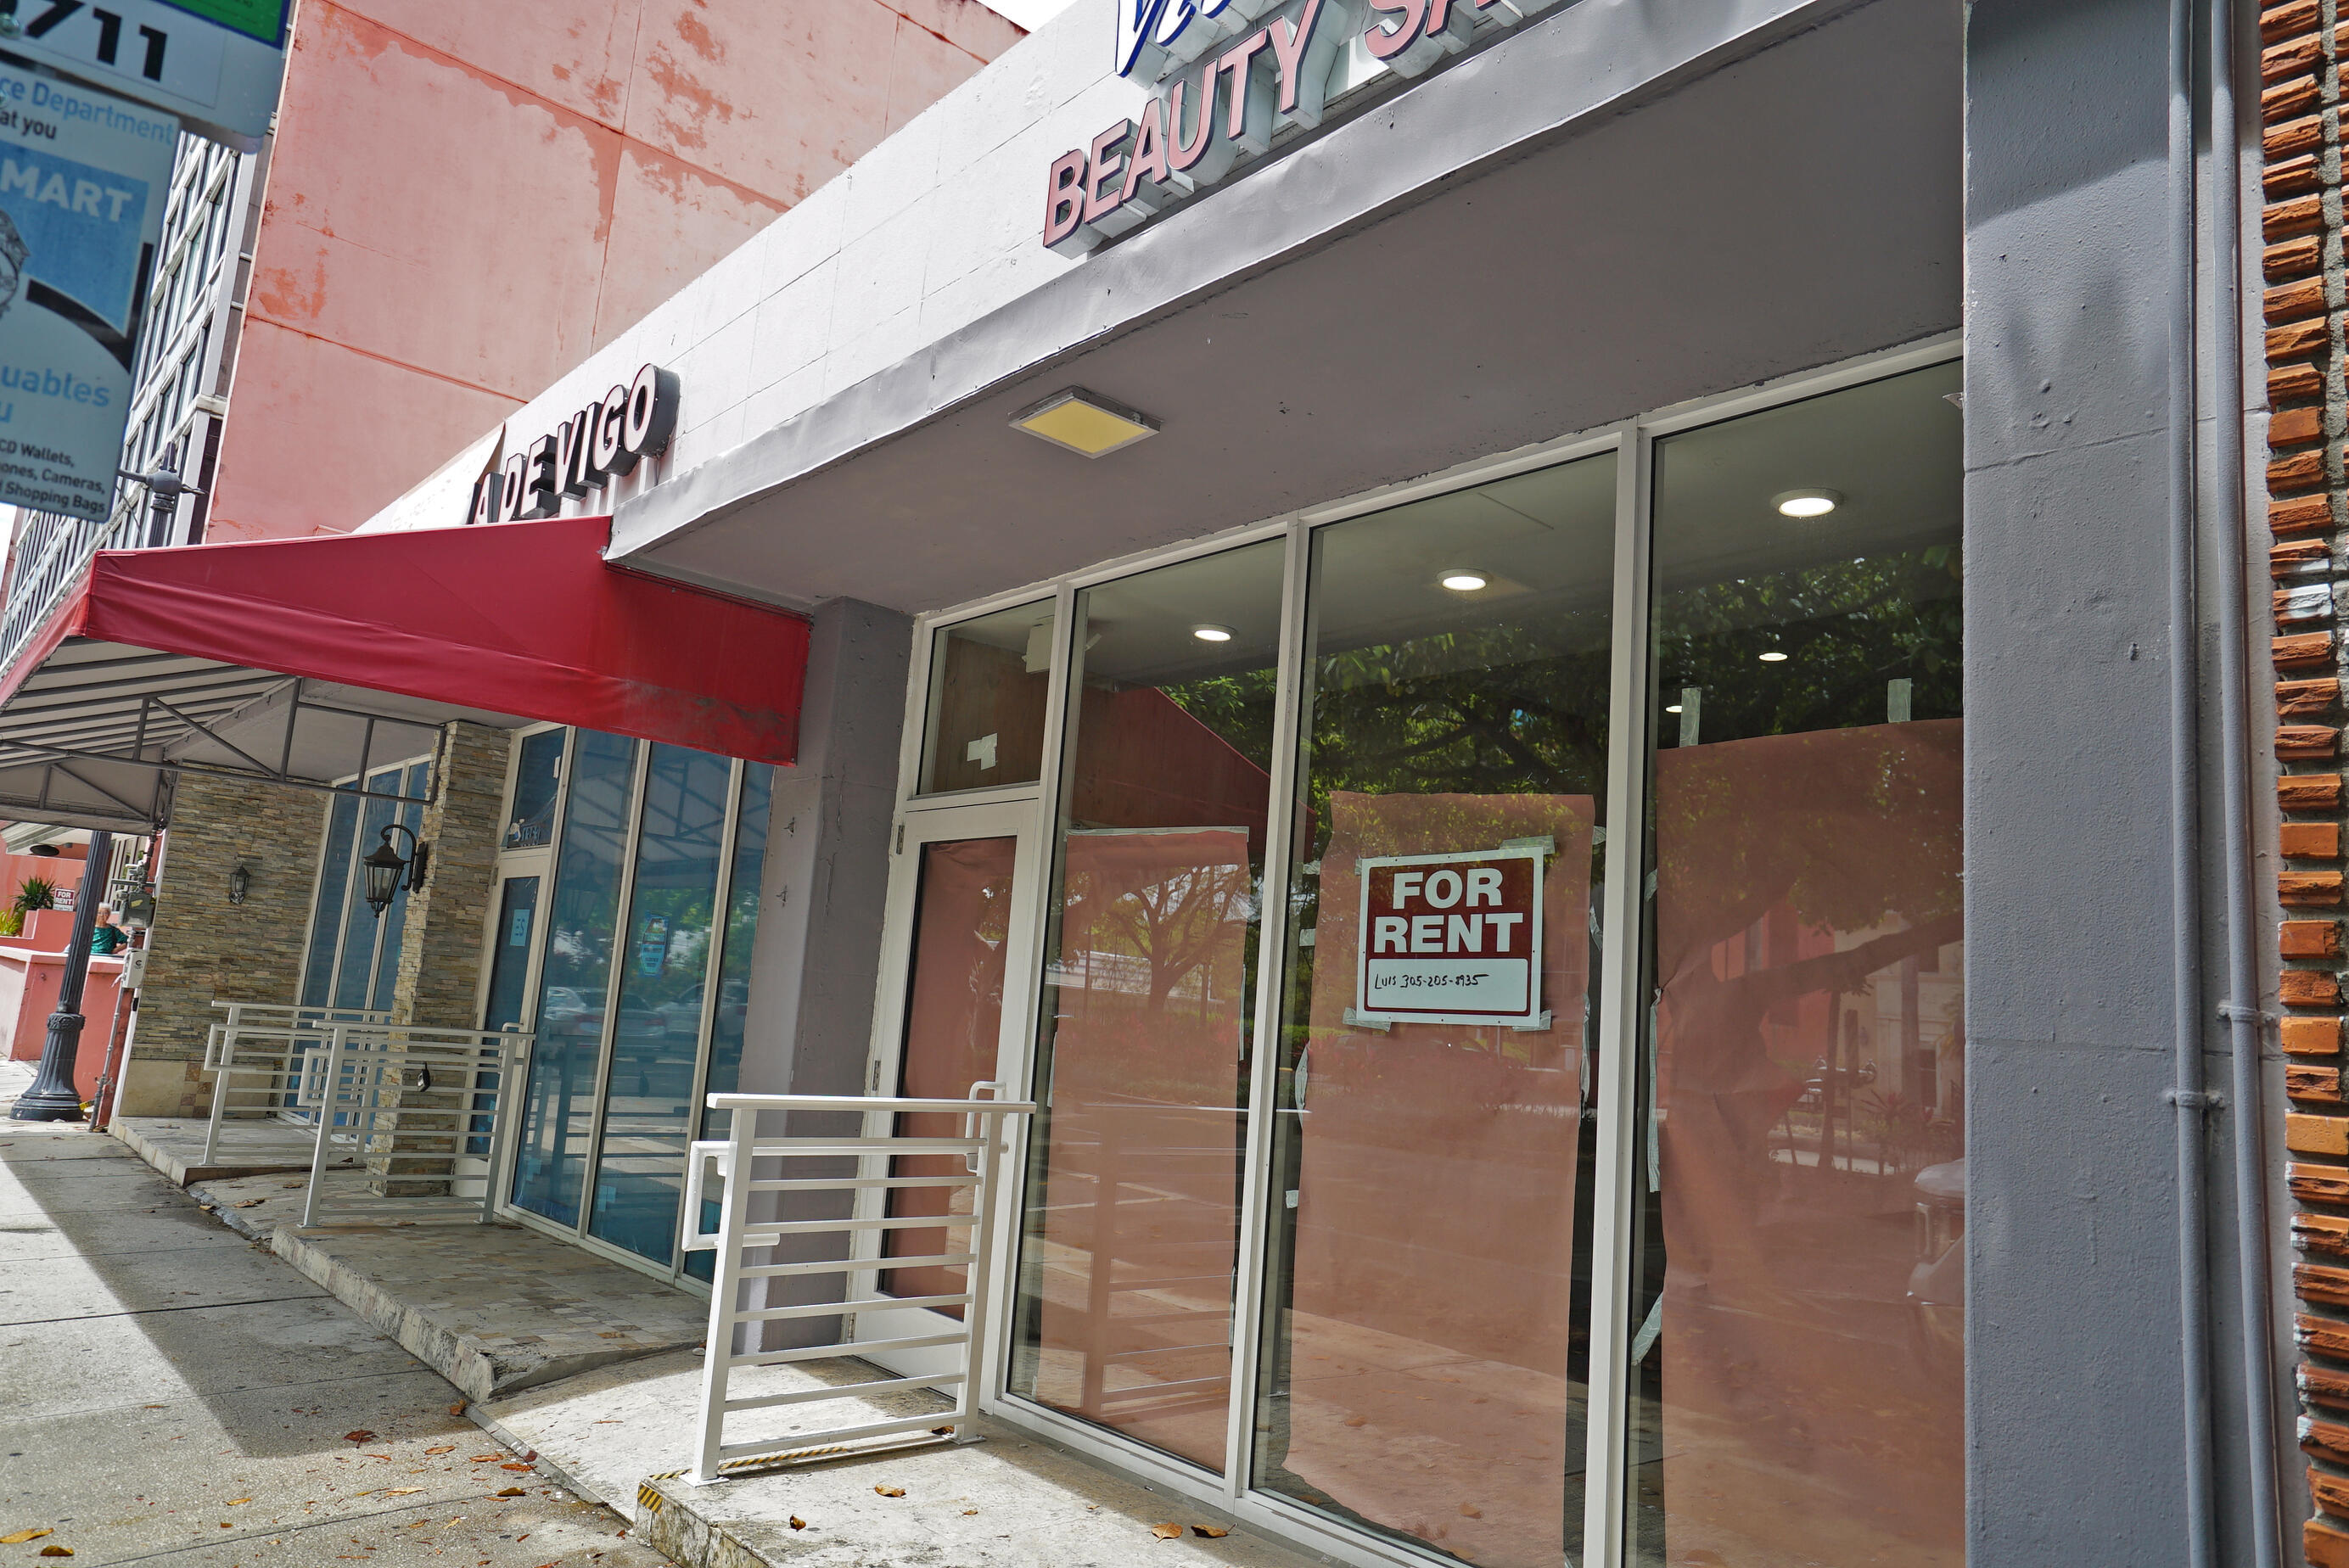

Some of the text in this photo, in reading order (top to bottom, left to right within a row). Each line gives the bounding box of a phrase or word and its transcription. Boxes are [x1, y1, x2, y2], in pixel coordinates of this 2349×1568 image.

[0, 0, 167, 82] 711
[22, 116, 57, 140] you
[32, 81, 175, 146] Department
[1043, 0, 1326, 249] BEAUTY
[0, 158, 133, 222] MART
[554, 363, 666, 497] VIGO
[21, 443, 75, 468] Wallets,
[5, 480, 70, 509] Shopping
[72, 494, 106, 514] Bags
[42, 468, 105, 495] Cameras,
[1393, 867, 1503, 910] FOR
[1374, 912, 1523, 954] RENT
